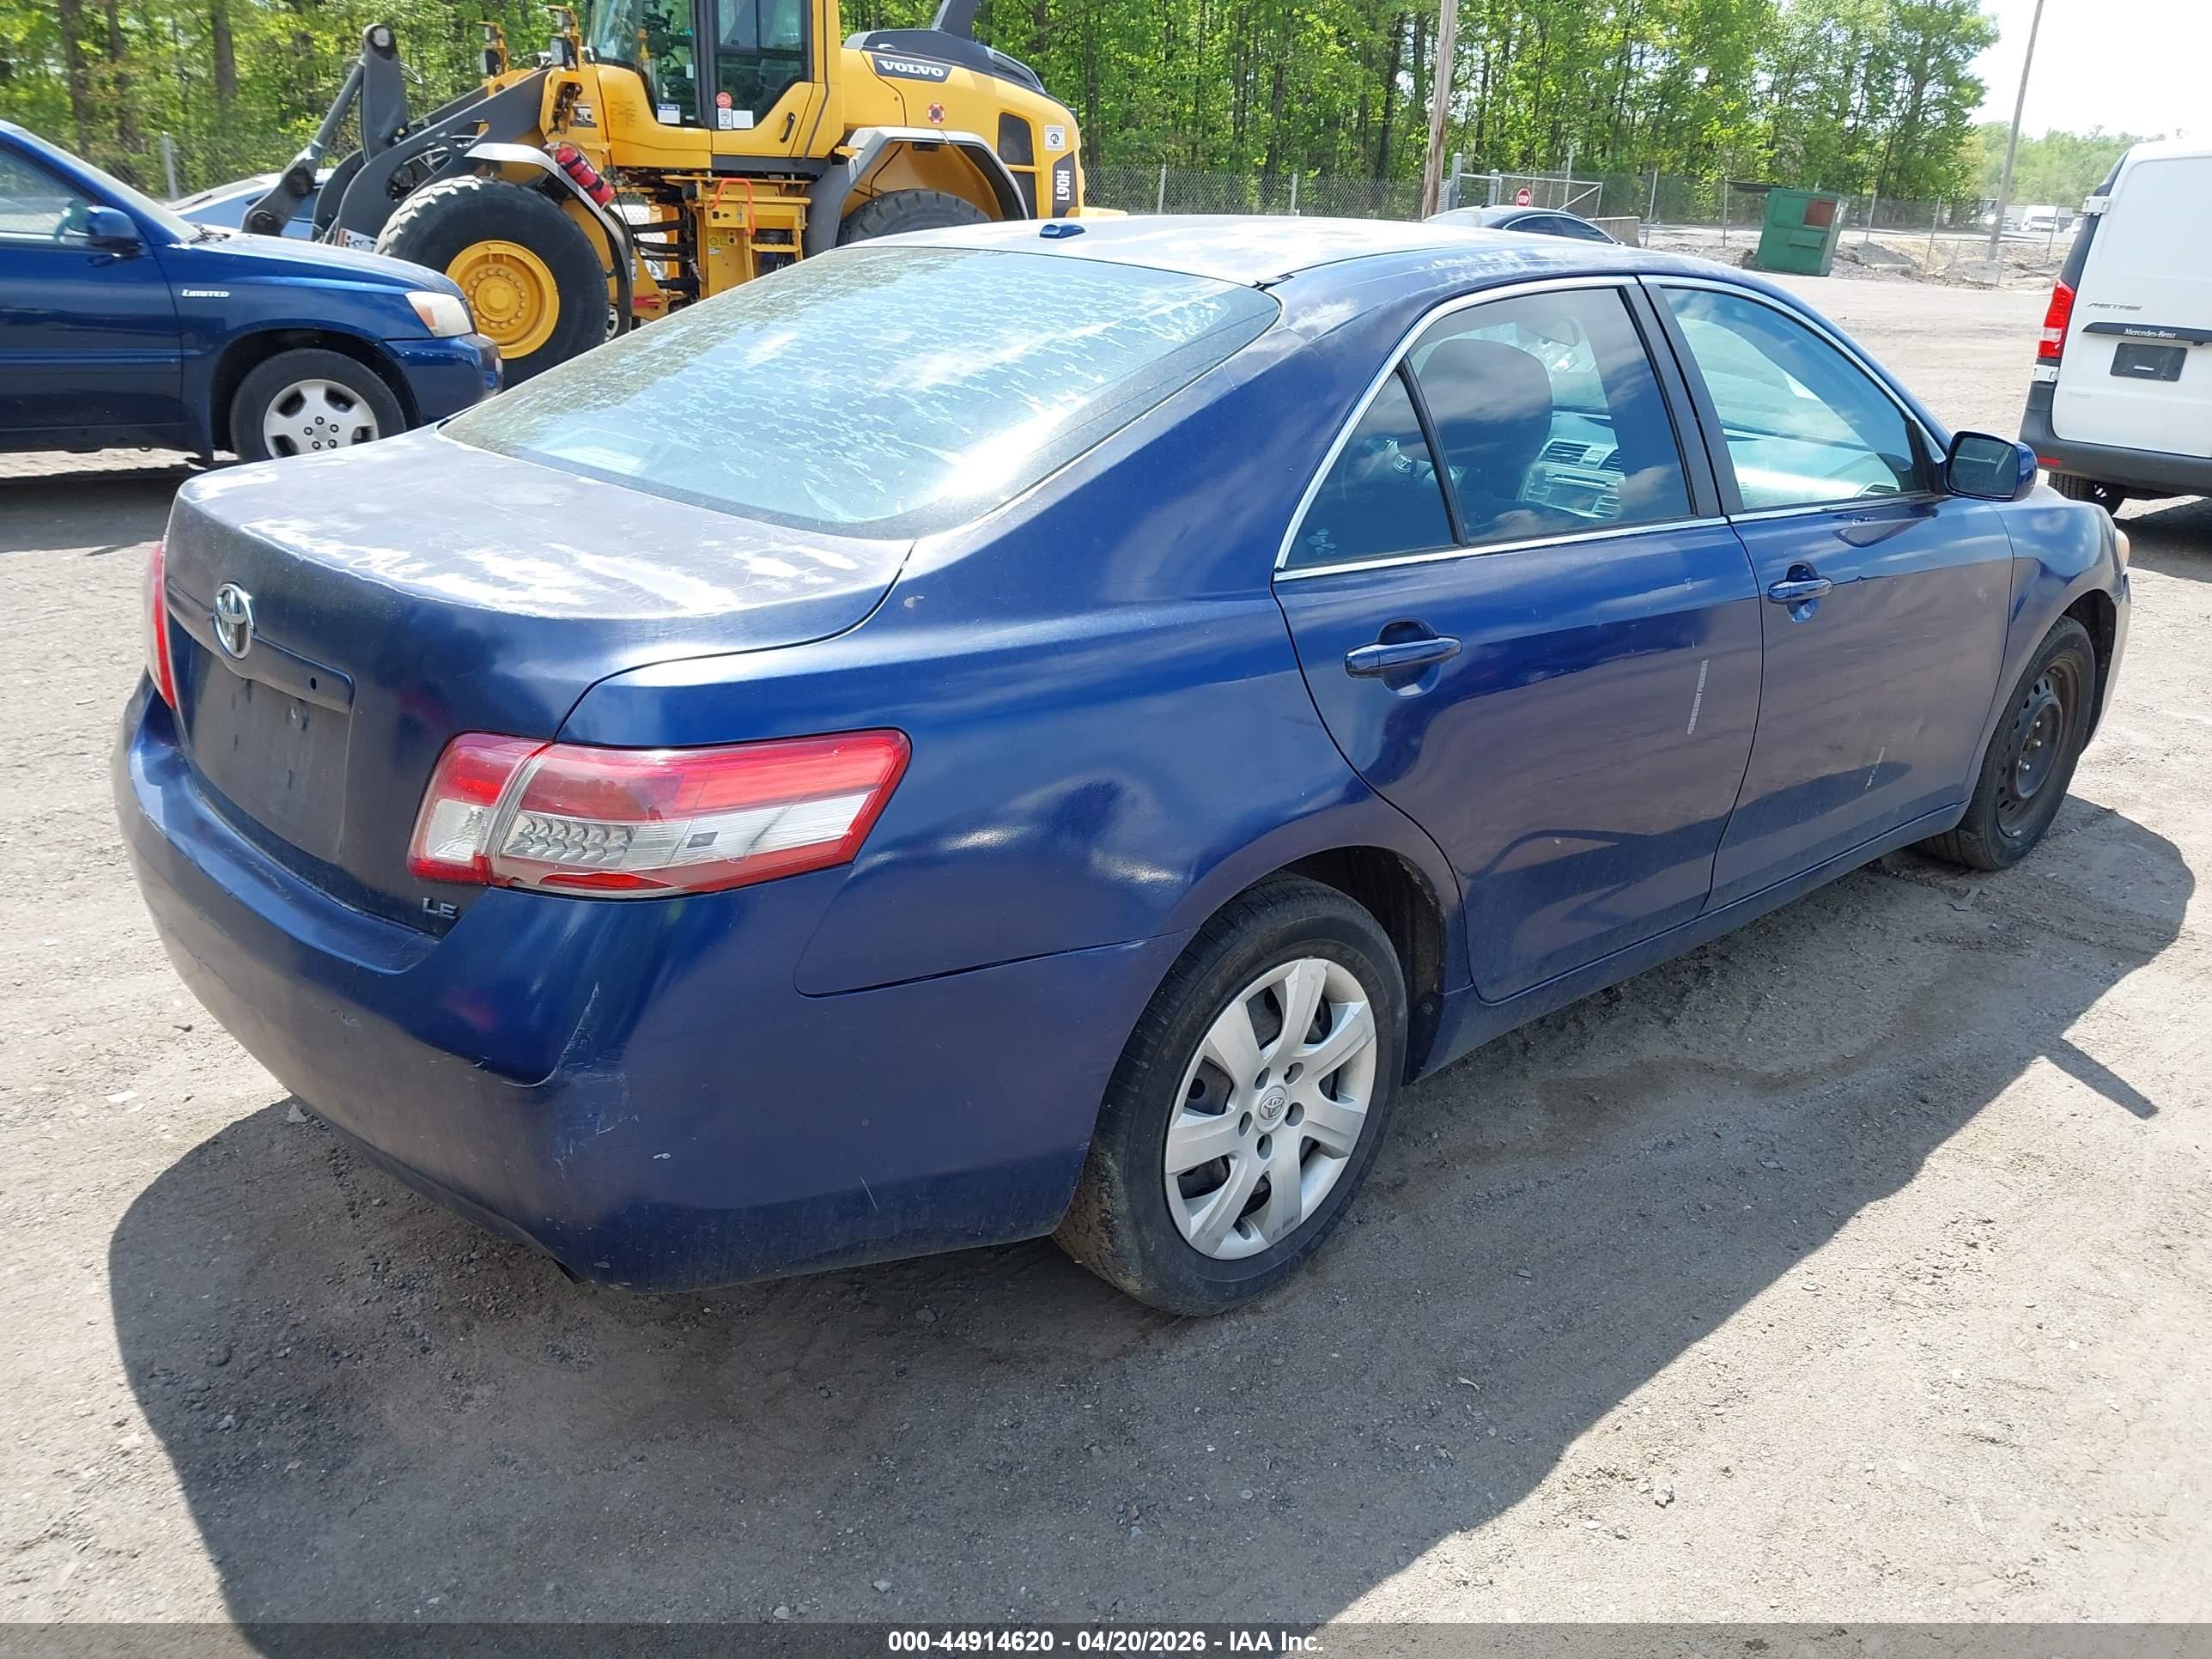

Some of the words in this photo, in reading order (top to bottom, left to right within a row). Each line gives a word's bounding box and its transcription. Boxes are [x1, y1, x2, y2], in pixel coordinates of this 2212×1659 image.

[878, 59, 945, 77] VOLVO
[1056, 170, 1070, 201] L90H
[2124, 328, 2177, 339] Mercedes-Benz
[422, 897, 458, 919] LE
